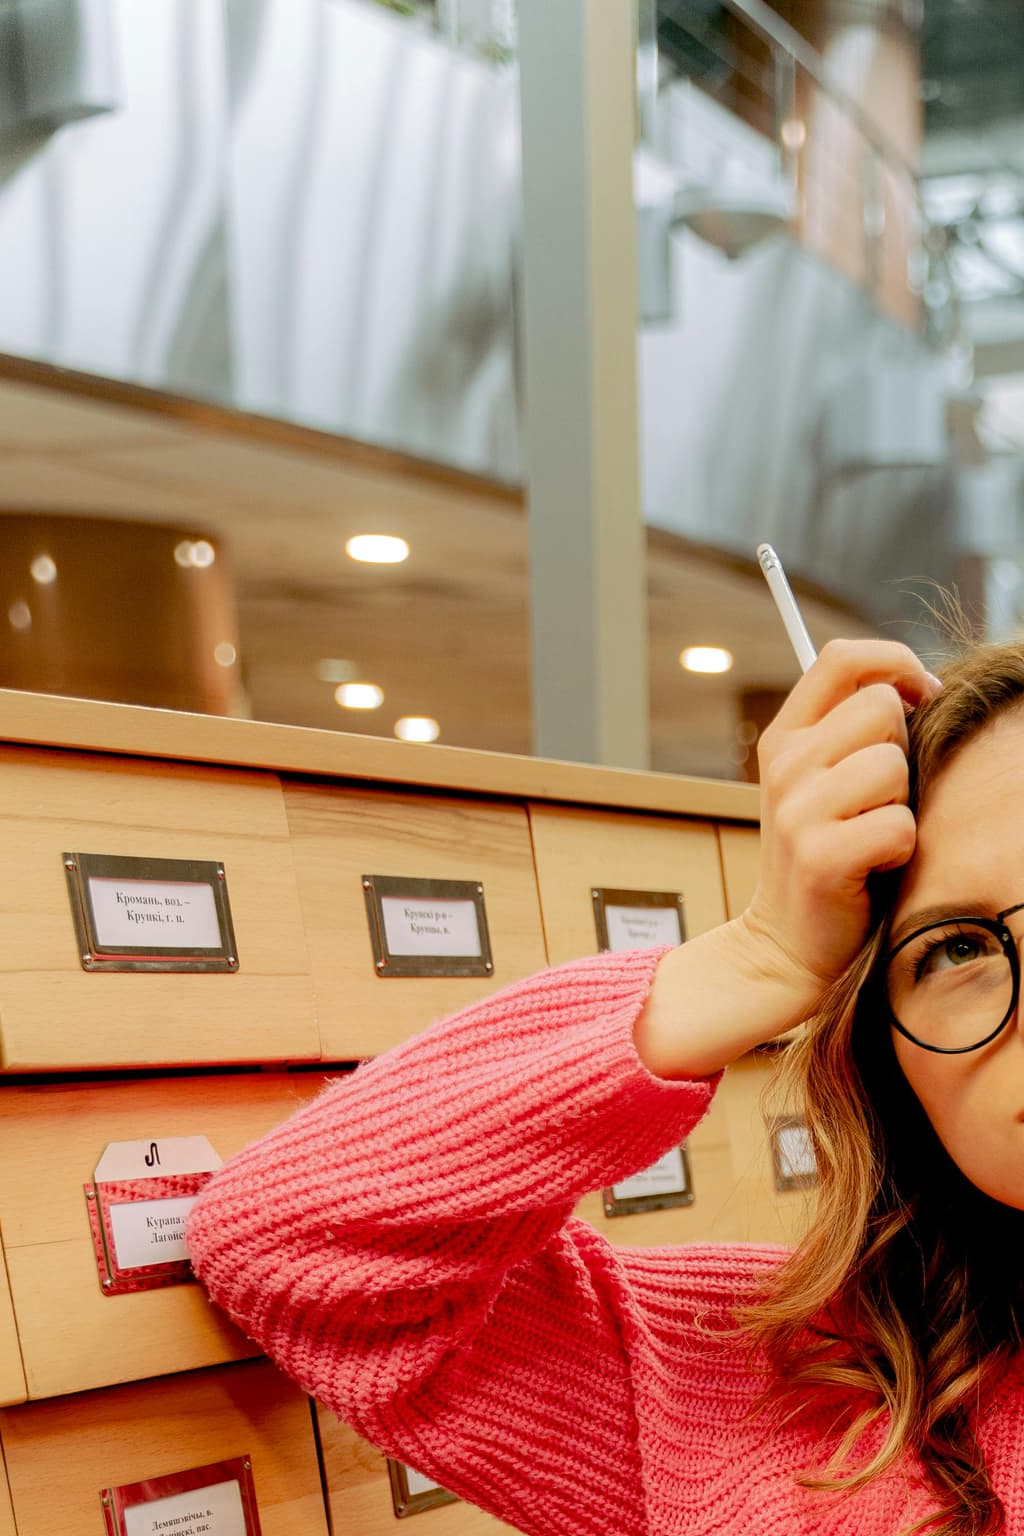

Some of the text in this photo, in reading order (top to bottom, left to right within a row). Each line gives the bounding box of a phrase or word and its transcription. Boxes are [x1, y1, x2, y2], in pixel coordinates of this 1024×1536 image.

[115, 891, 163, 906] Кромань,
[165, 898, 183, 907] воз.
[126, 909, 165, 924] Крупкі,
[146, 1215, 185, 1230] Курапа
